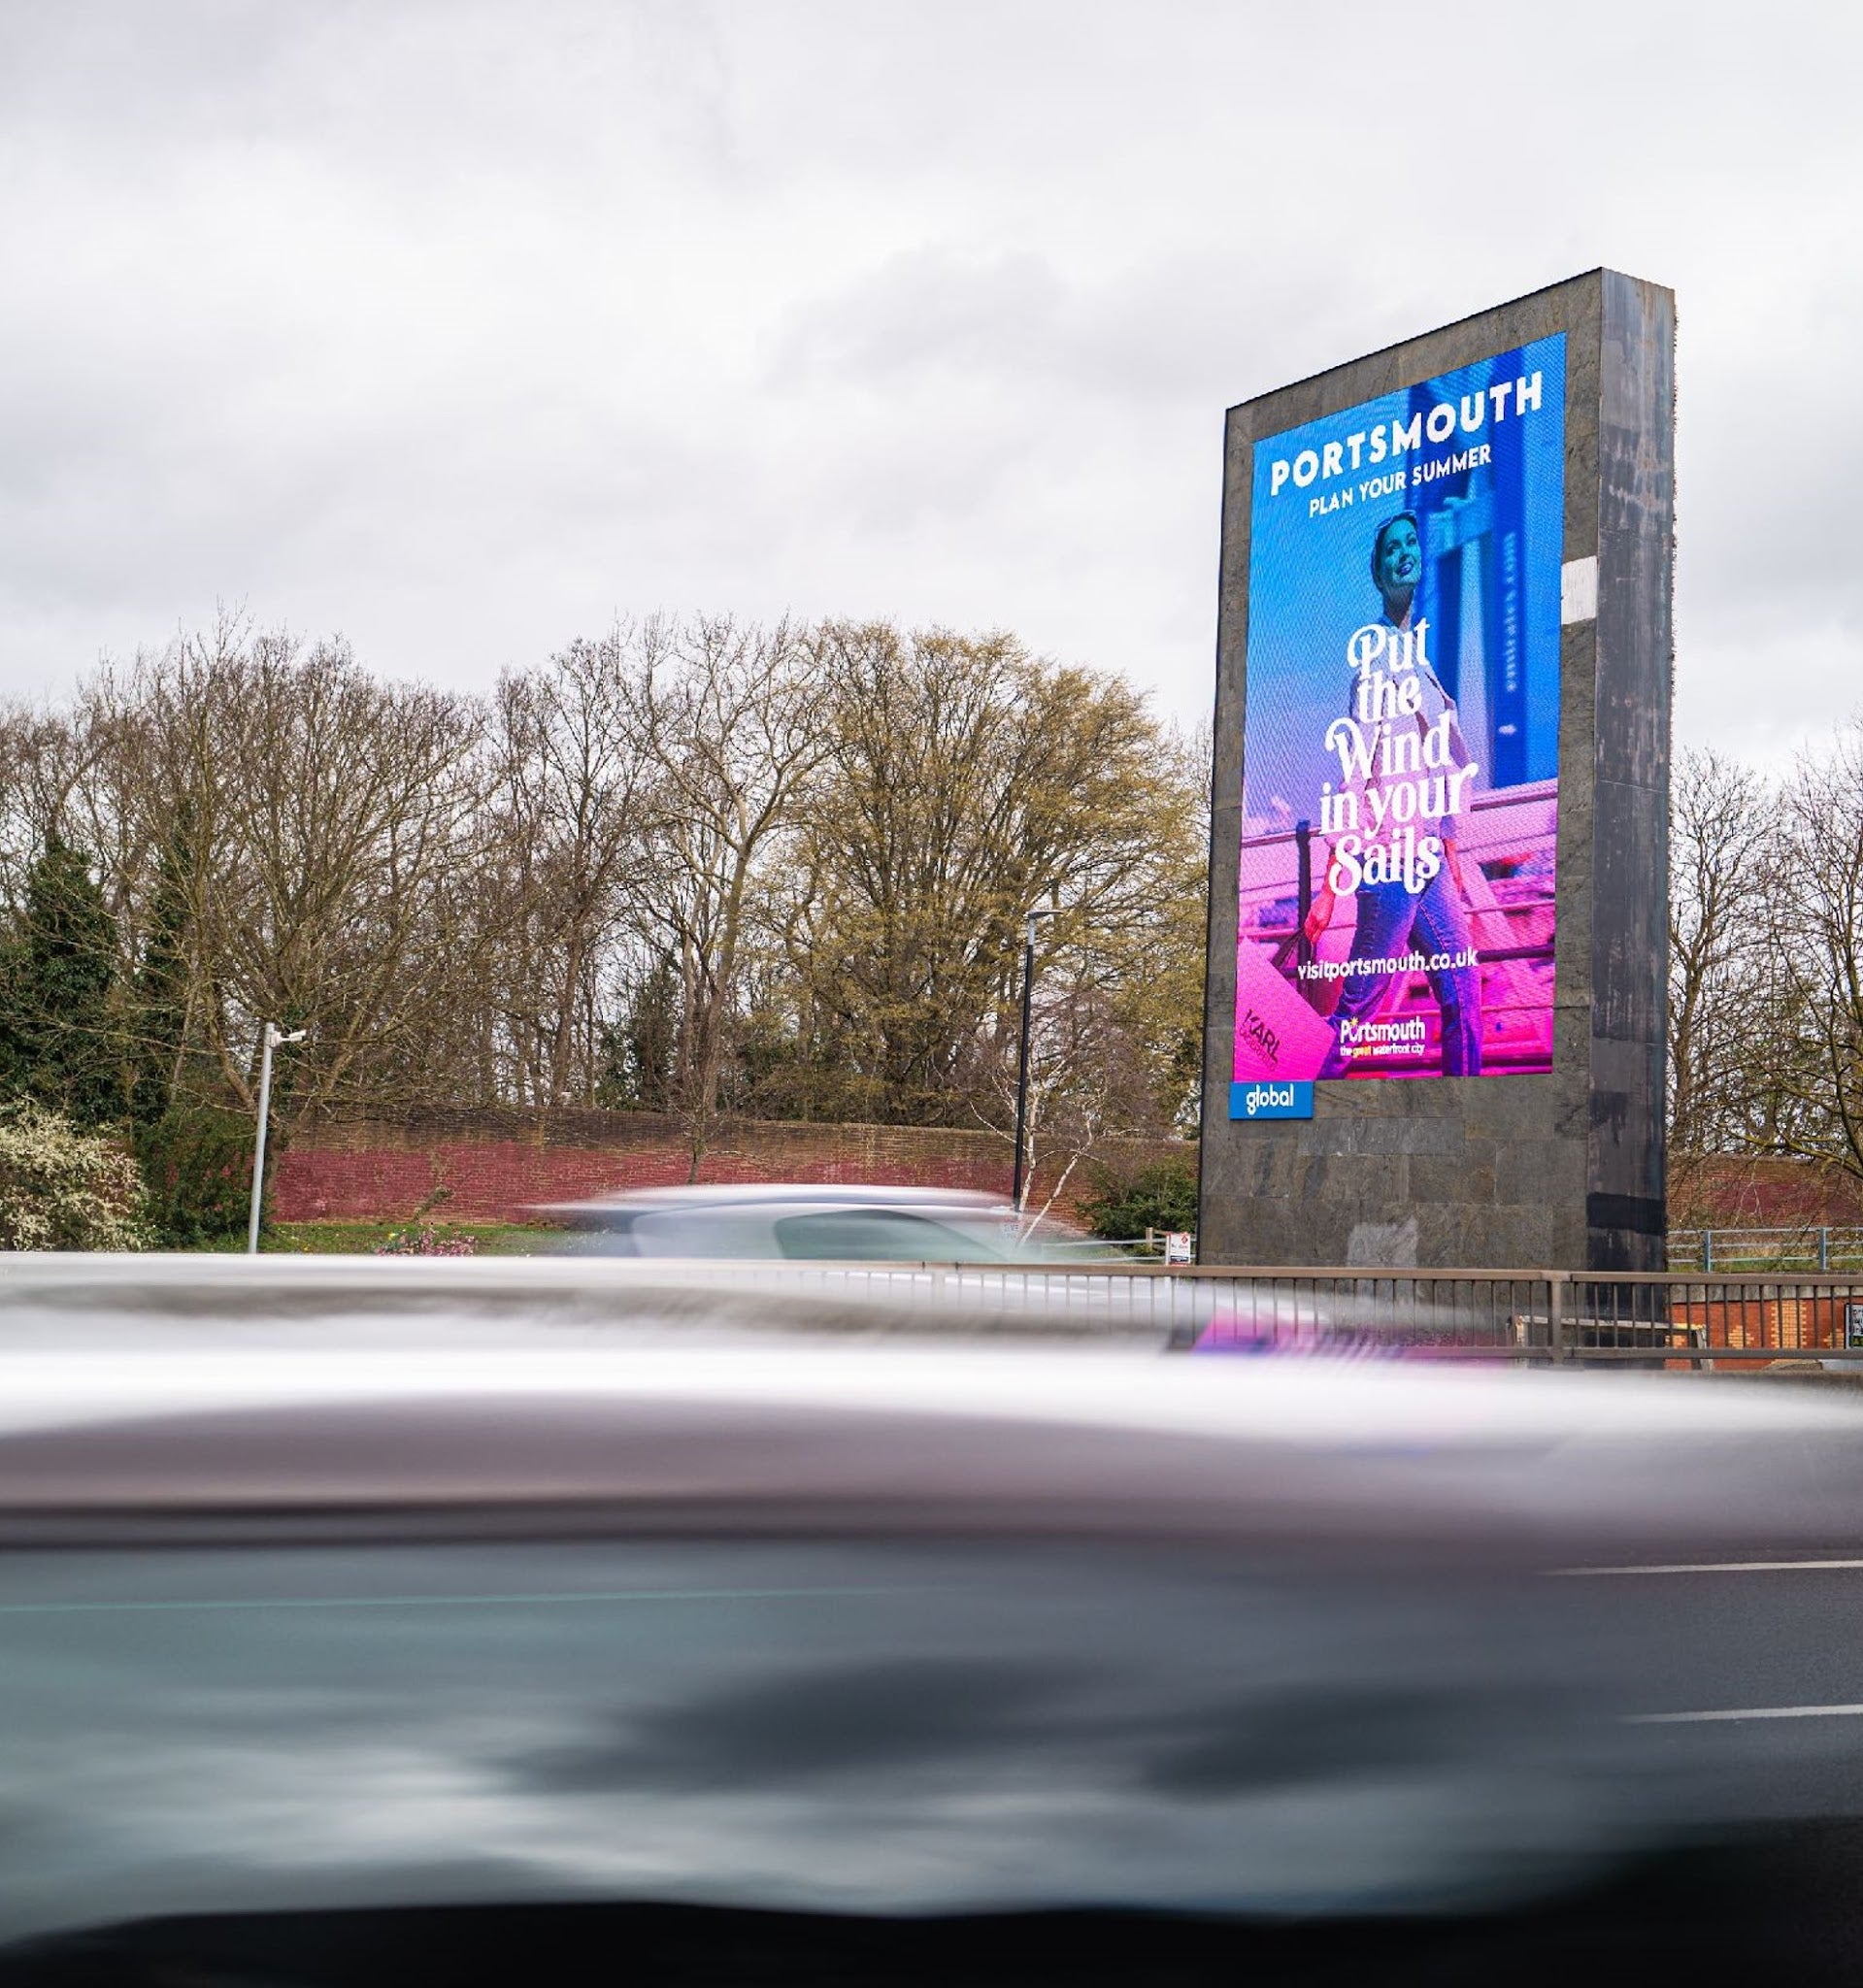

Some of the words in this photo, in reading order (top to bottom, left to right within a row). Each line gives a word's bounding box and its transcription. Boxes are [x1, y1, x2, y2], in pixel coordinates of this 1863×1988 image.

[1270, 371, 1543, 496] PORTSMOUTH
[1309, 486, 1353, 518] PLAN
[1359, 472, 1407, 501] YOUR
[1412, 444, 1491, 486] SUMMER
[1347, 617, 1430, 679] Put
[1356, 672, 1423, 723] the
[1324, 710, 1453, 780] Wind
[1318, 781, 1362, 836] in
[1361, 762, 1480, 841] your
[1328, 824, 1442, 897] Sails
[1297, 946, 1479, 982] visitportsmouth.co.uk
[1242, 1009, 1281, 1064] KARL
[1340, 1015, 1426, 1044] Portsmouth
[1246, 1084, 1294, 1116] global
